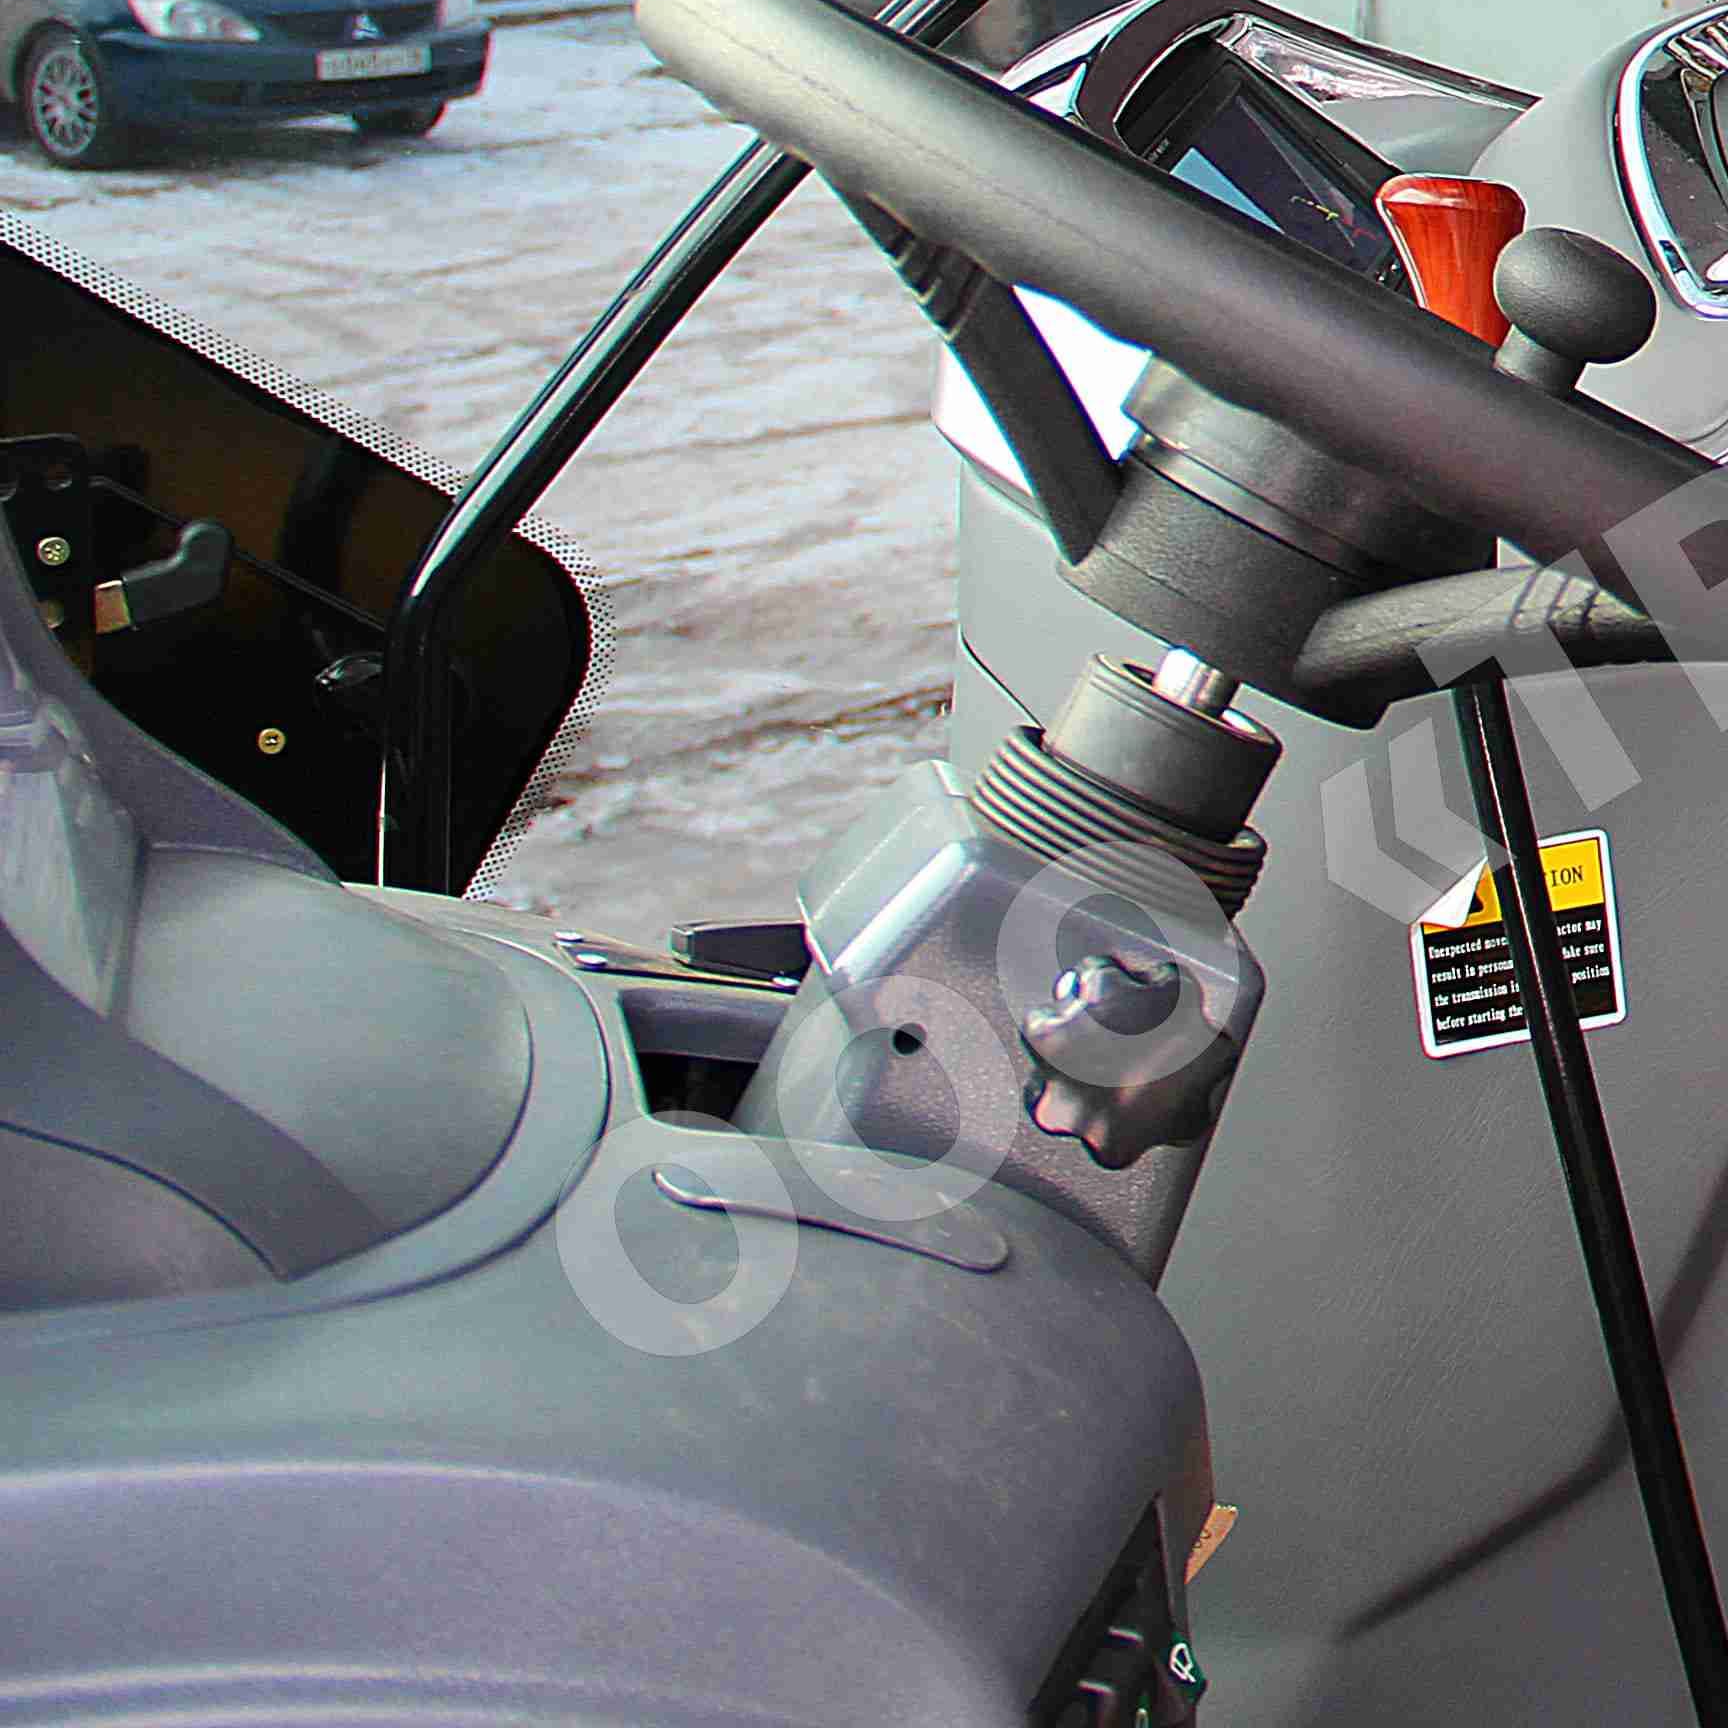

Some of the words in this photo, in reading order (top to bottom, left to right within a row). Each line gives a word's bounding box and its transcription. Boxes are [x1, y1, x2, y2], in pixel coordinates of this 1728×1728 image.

[1431, 968, 1461, 985] result
[1583, 943, 1605, 958] sure
[1434, 991, 1449, 1007] the
[1571, 963, 1611, 984] position
[1436, 1013, 1466, 1032] before
[1467, 1005, 1506, 1026] starting
